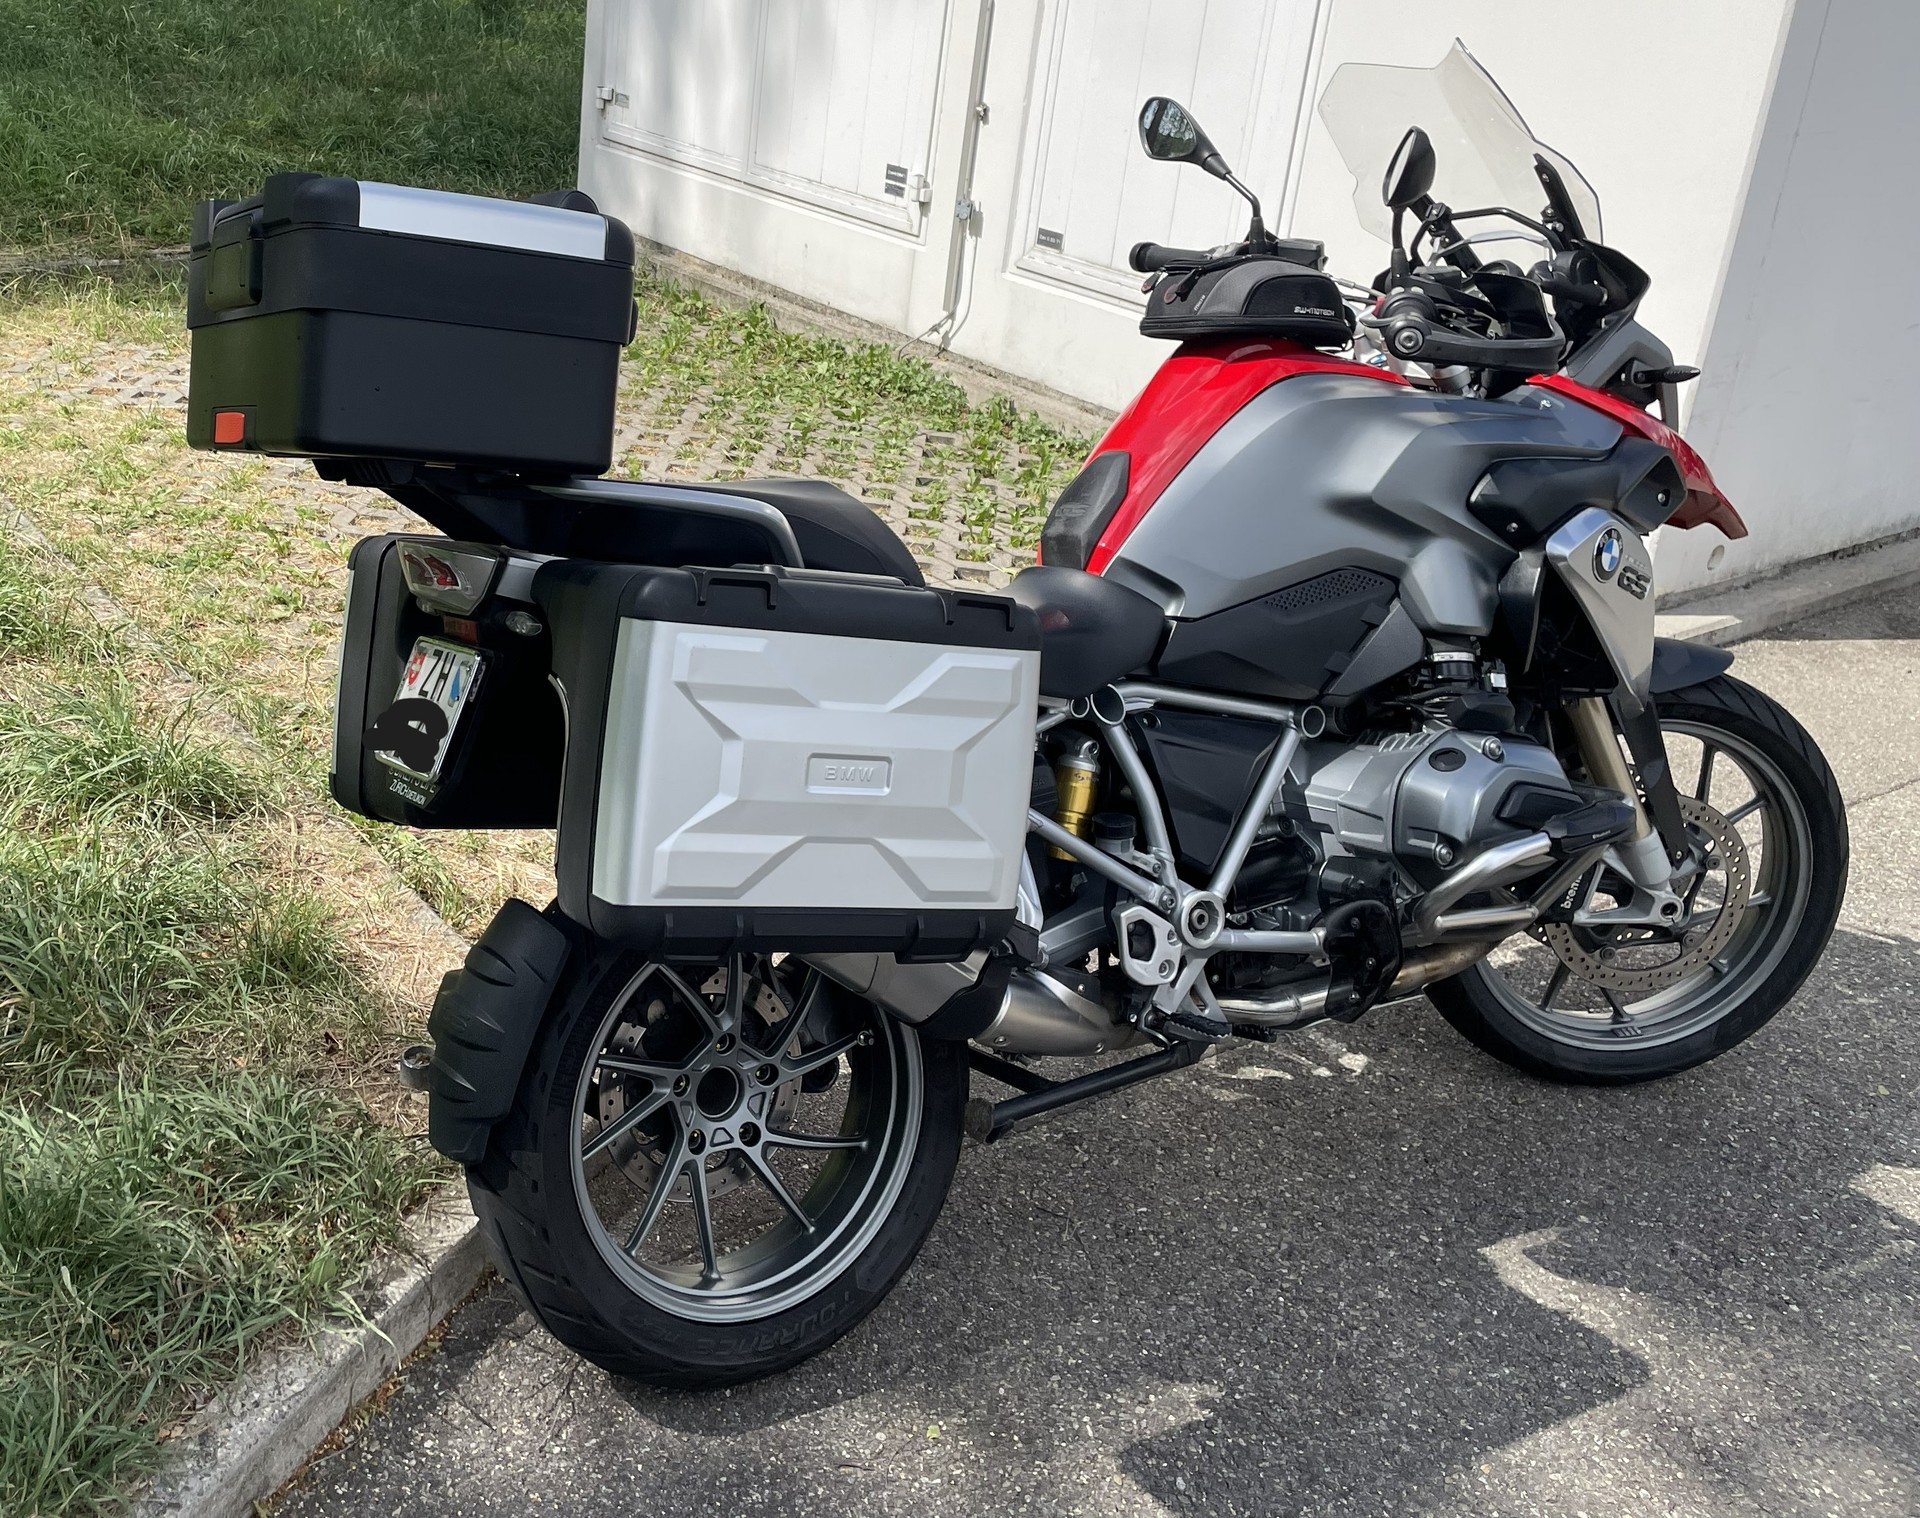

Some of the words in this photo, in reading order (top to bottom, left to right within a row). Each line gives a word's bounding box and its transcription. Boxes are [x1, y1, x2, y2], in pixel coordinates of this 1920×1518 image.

[1617, 566, 1651, 600] GS
[418, 648, 457, 702] ZH
[824, 765, 874, 782] BMW
[1560, 873, 1583, 909] brem
